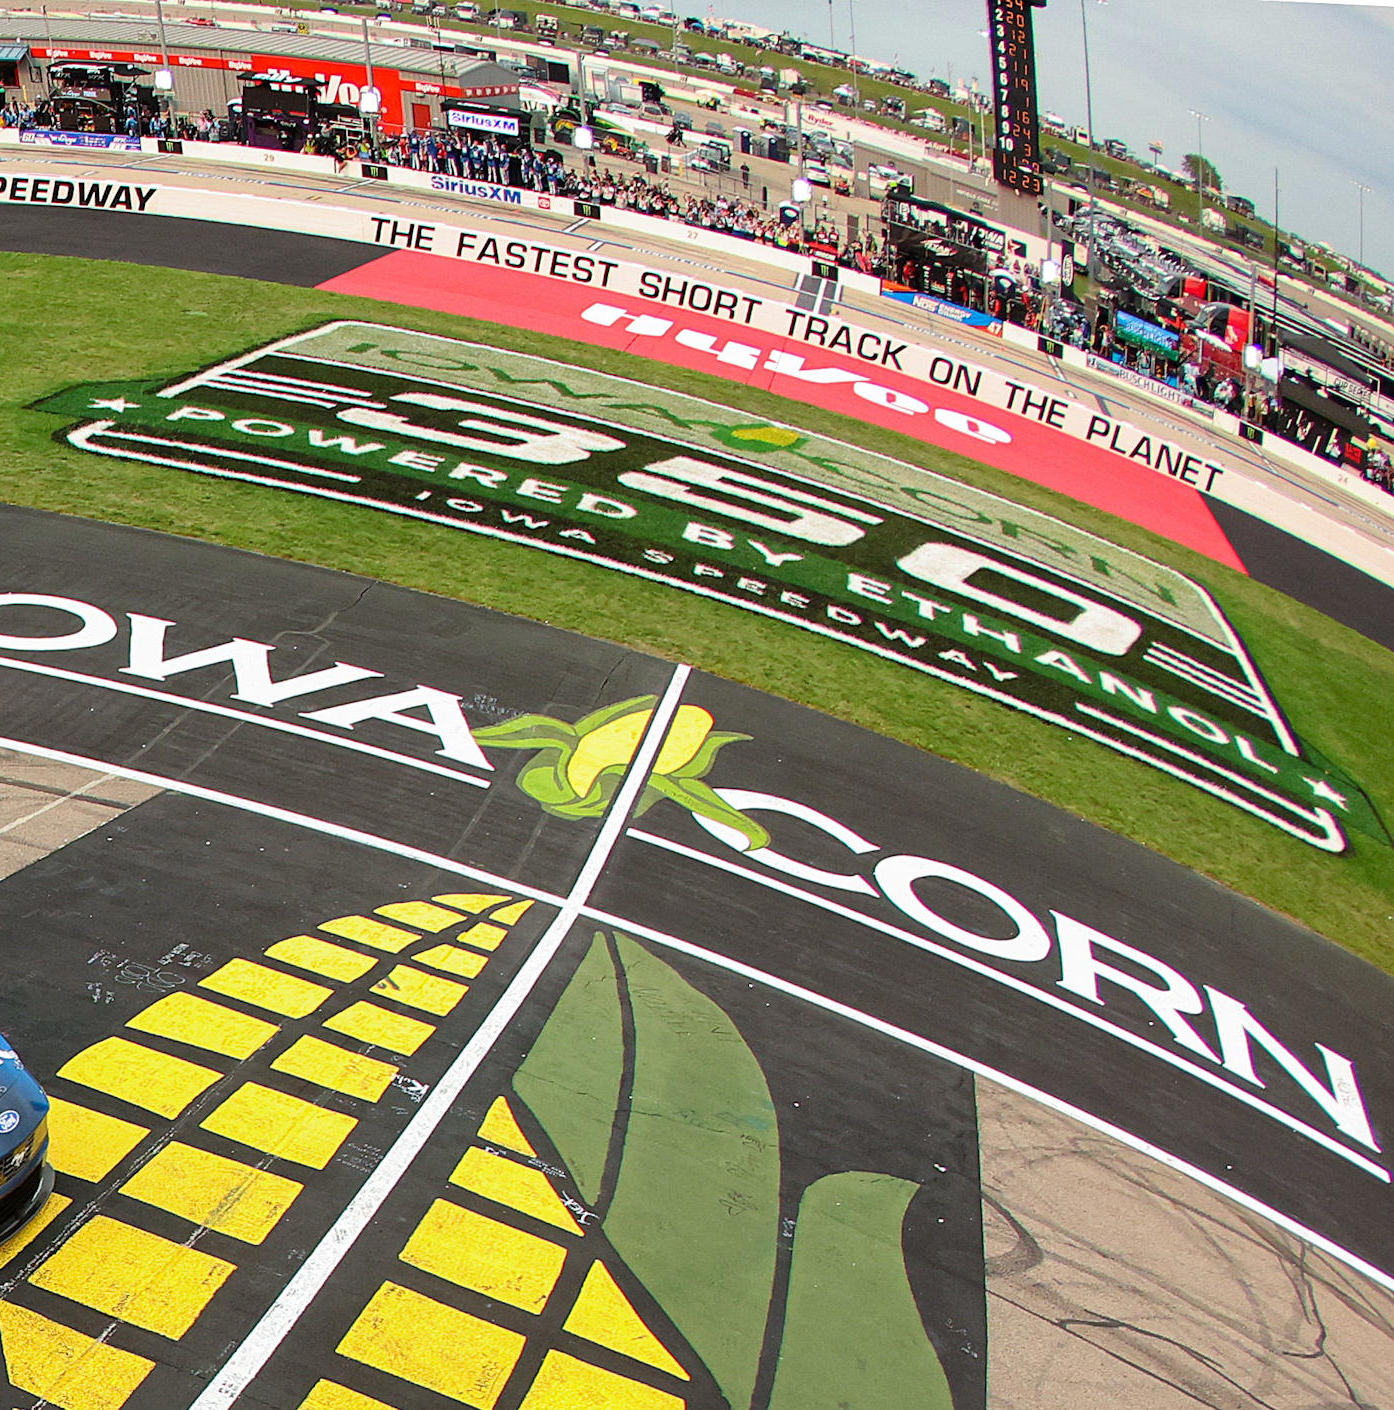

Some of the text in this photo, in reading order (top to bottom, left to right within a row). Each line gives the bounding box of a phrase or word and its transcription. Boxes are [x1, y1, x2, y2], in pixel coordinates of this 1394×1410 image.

[995, 8, 1003, 21] 2
[996, 24, 1005, 37] 3
[997, 41, 1006, 53] 4
[998, 57, 1007, 69] 5
[1000, 73, 1008, 85] 6
[1000, 89, 1008, 101] 7
[1001, 105, 1009, 117] 8
[451, 112, 516, 131] SiriusXM
[1001, 121, 1010, 134] 9
[999, 136, 1013, 151] 10
[430, 175, 522, 205] SiriusXM
[371, 216, 436, 252] THE
[456, 232, 619, 288] FASTEST
[639, 272, 763, 325] SHORT
[784, 308, 909, 371] TRACK
[929, 356, 982, 396] ON
[1005, 381, 1069, 429] THE
[1085, 415, 1225, 493] PLANET
[581, 302, 1012, 444] HyVee
[337, 389, 1145, 657] 350
[165, 404, 1280, 775] POWERED BY ETHANOL
[415, 489, 1018, 683] IOWA SPEEDWAY
[691, 786, 1383, 1155] CORN
